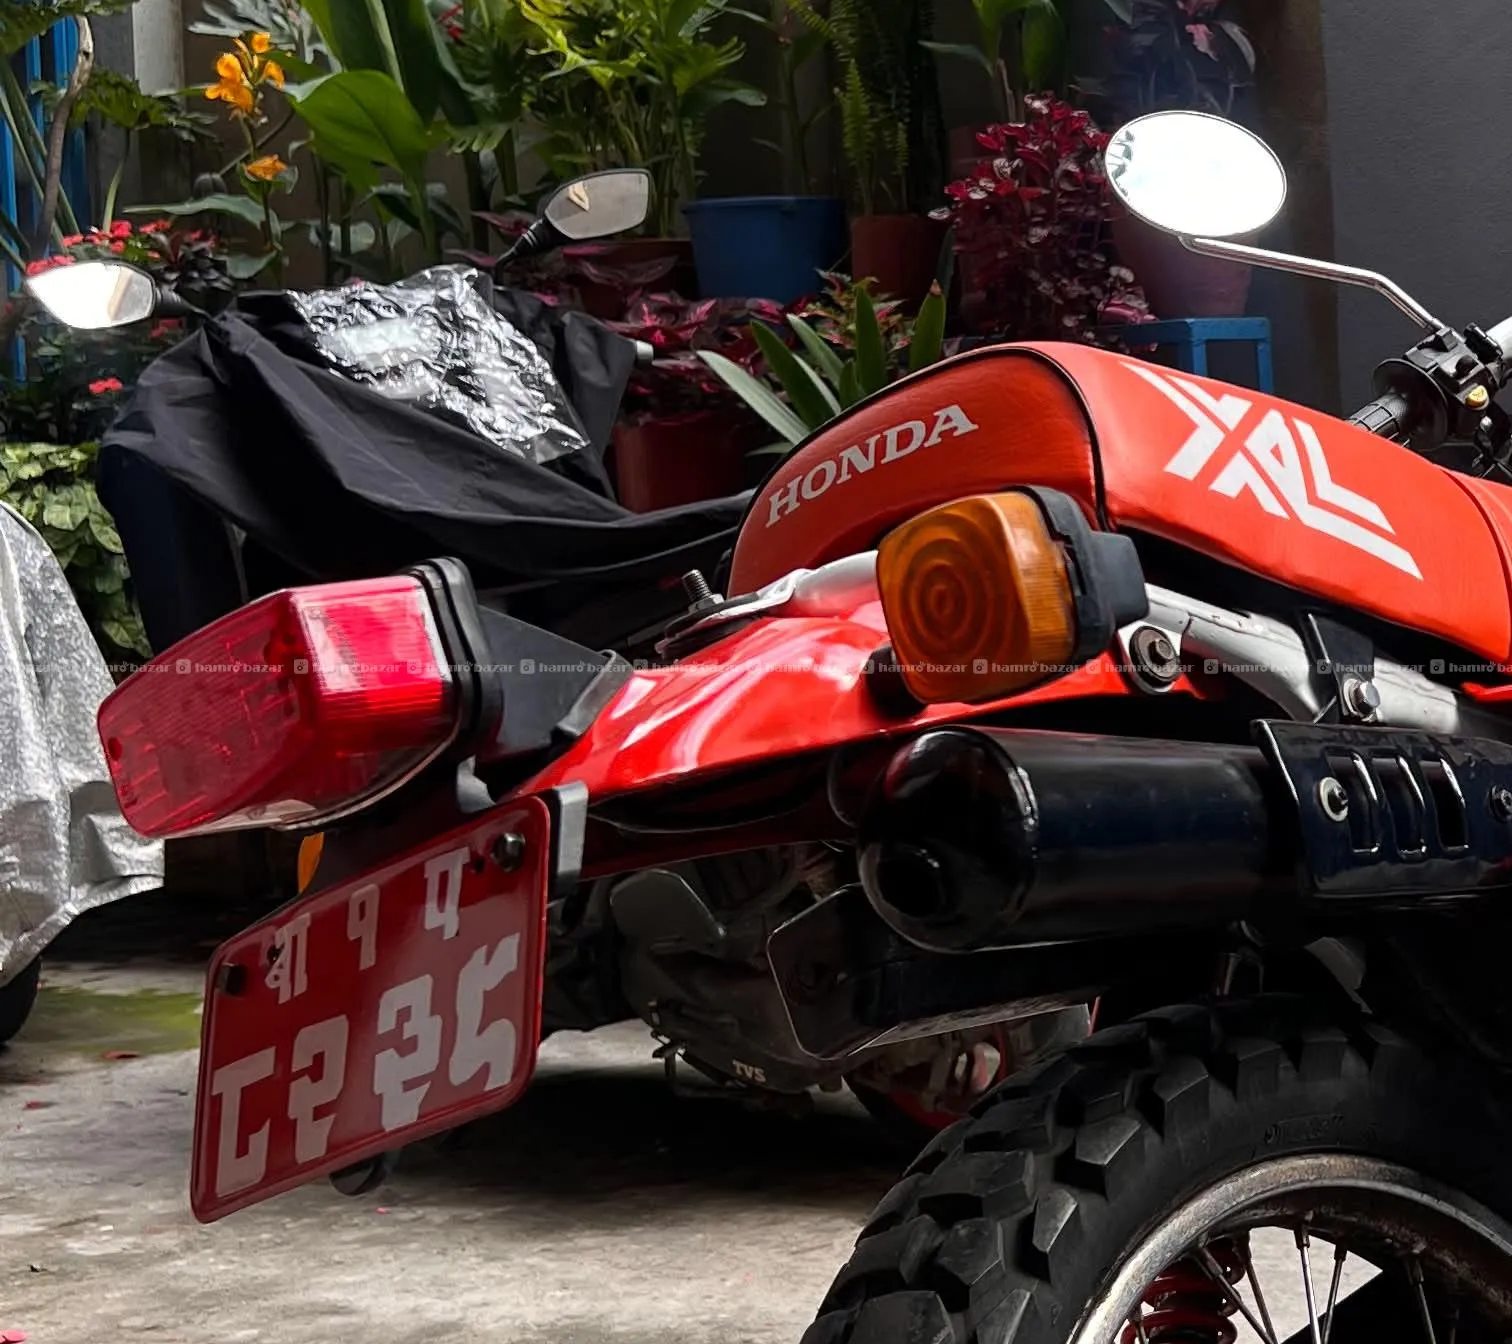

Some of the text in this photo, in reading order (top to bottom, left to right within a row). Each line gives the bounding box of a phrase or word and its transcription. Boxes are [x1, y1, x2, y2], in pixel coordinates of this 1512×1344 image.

[765, 404, 979, 528] HONDA
[347, 883, 380, 971] १
[424, 847, 471, 940] प
[732, 1058, 767, 1084] TVS
